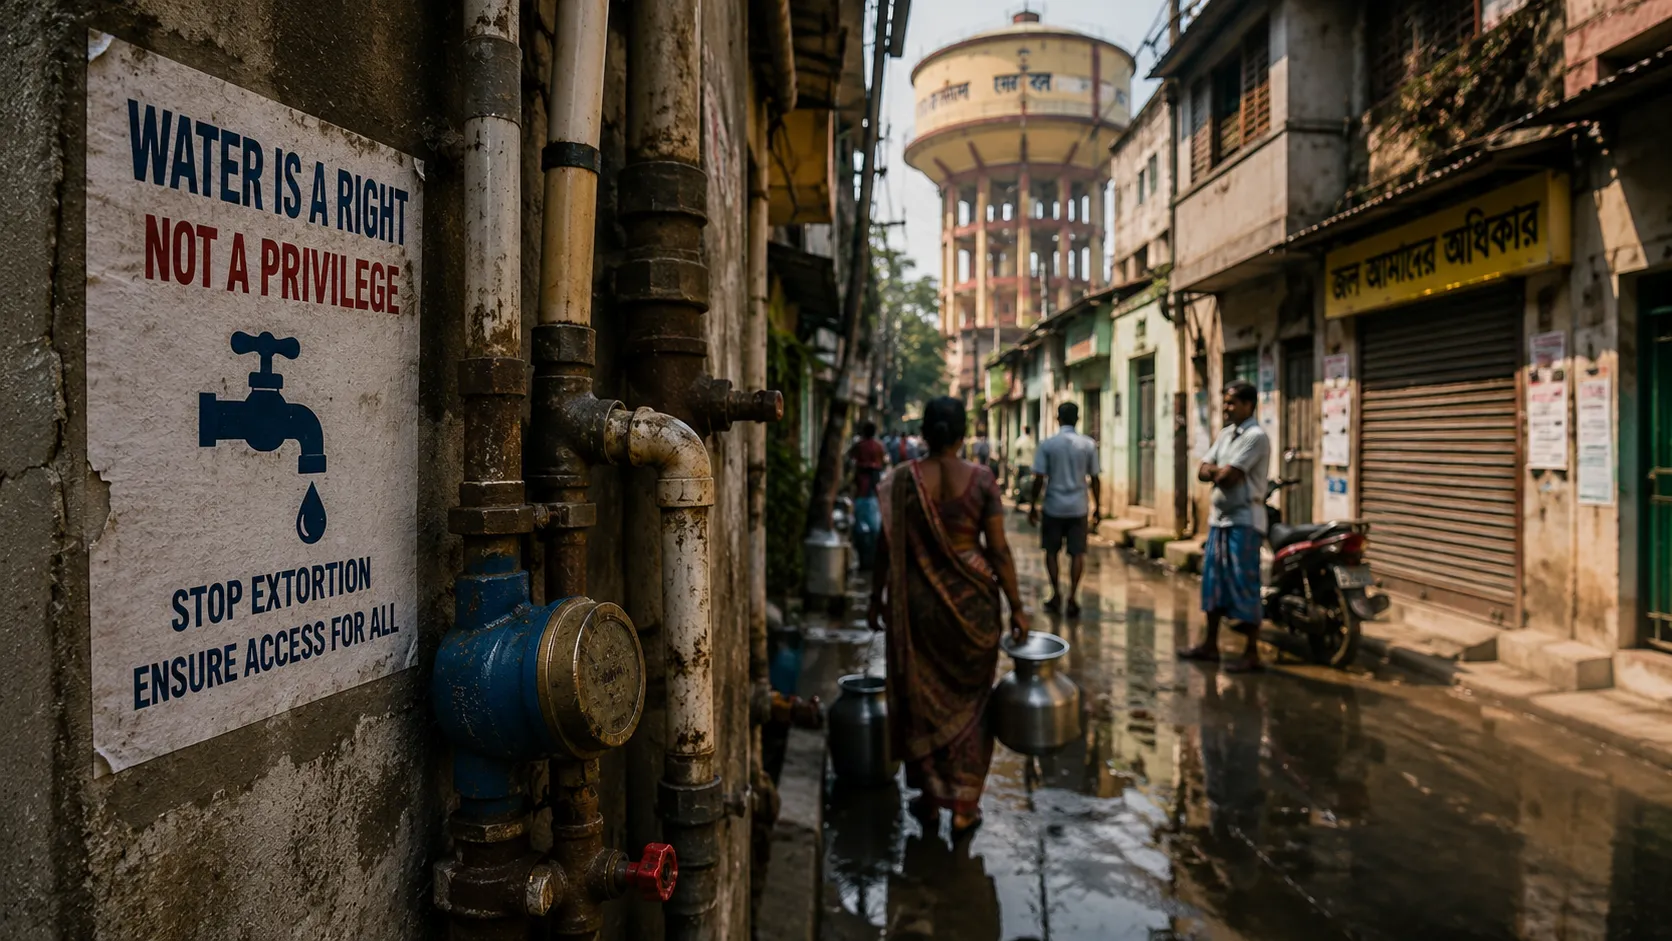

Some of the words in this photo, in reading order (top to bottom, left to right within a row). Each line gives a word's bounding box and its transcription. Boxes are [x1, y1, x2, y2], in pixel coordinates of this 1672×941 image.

[128, 98, 264, 210] WATER
[274, 147, 302, 219] IS
[309, 161, 328, 227] A
[337, 168, 409, 246] RIGHT
[145, 214, 218, 288] NOT
[226, 232, 250, 294] A
[260, 238, 400, 315] PRIVILEGE
[1331, 262, 1361, 300] জল
[1442, 200, 1540, 265] অধিকার
[172, 579, 243, 632] STOP
[251, 556, 372, 614] EXTORTION
[133, 642, 238, 711] ENSURE
[244, 620, 326, 677] ACCESS
[330, 610, 366, 651] FOR
[369, 602, 400, 640] ALL
